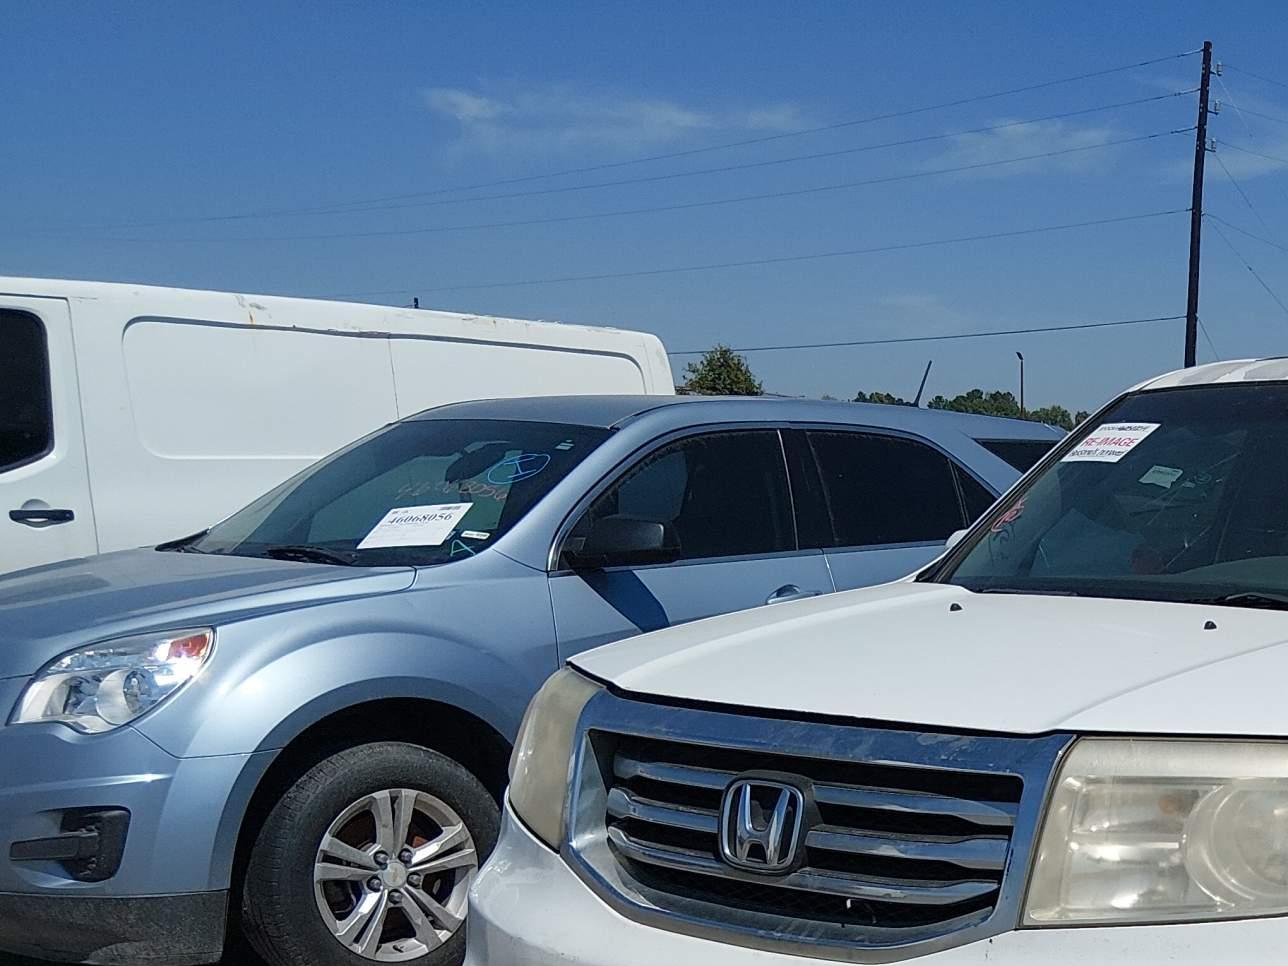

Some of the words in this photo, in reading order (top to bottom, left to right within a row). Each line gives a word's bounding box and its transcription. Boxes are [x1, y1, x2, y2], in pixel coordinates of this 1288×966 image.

[1080, 437, 1139, 448] RE-IMAGE
[388, 512, 453, 525] 46068056
[449, 539, 477, 557] A
